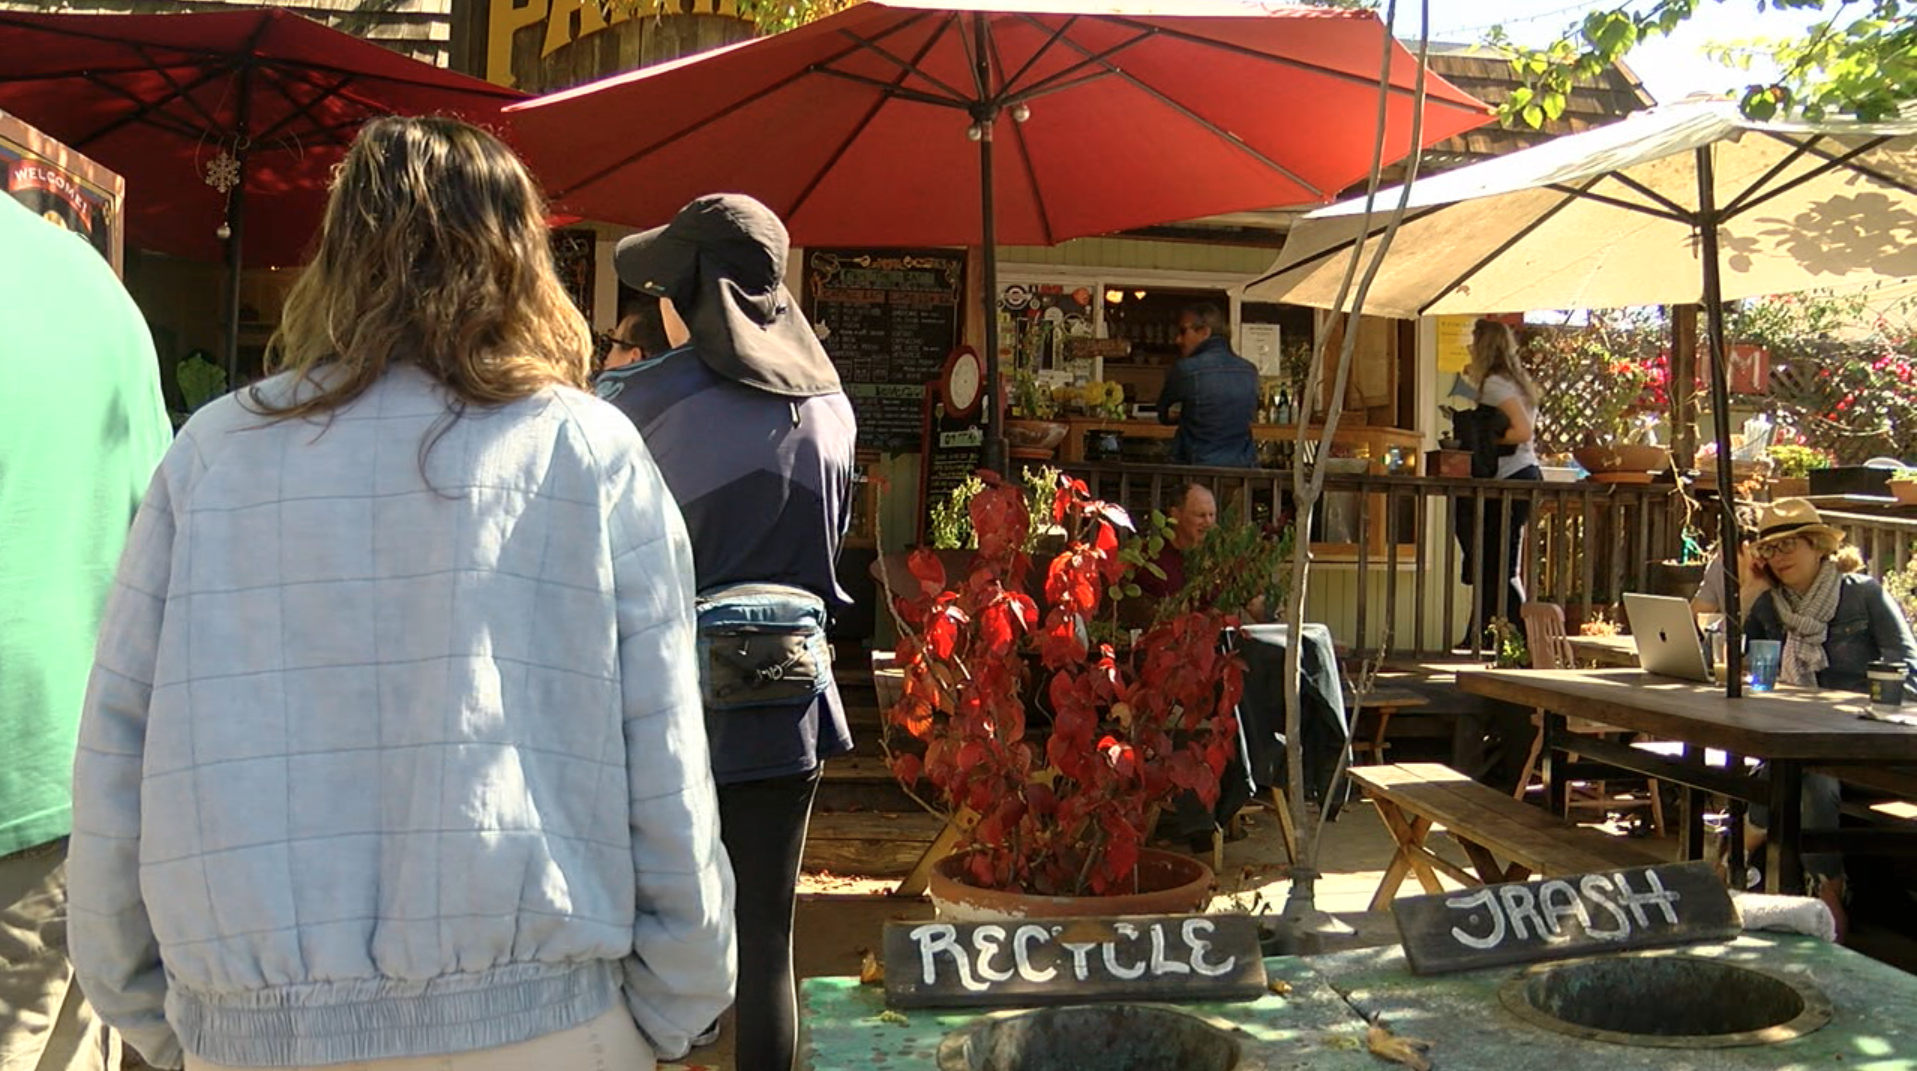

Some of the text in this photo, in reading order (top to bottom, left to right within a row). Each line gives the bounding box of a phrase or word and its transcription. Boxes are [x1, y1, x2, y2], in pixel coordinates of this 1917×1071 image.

[14, 167, 88, 214] WELCOME!
[1446, 869, 1681, 949] TRASH
[910, 918, 1236, 992] RECYCLE
